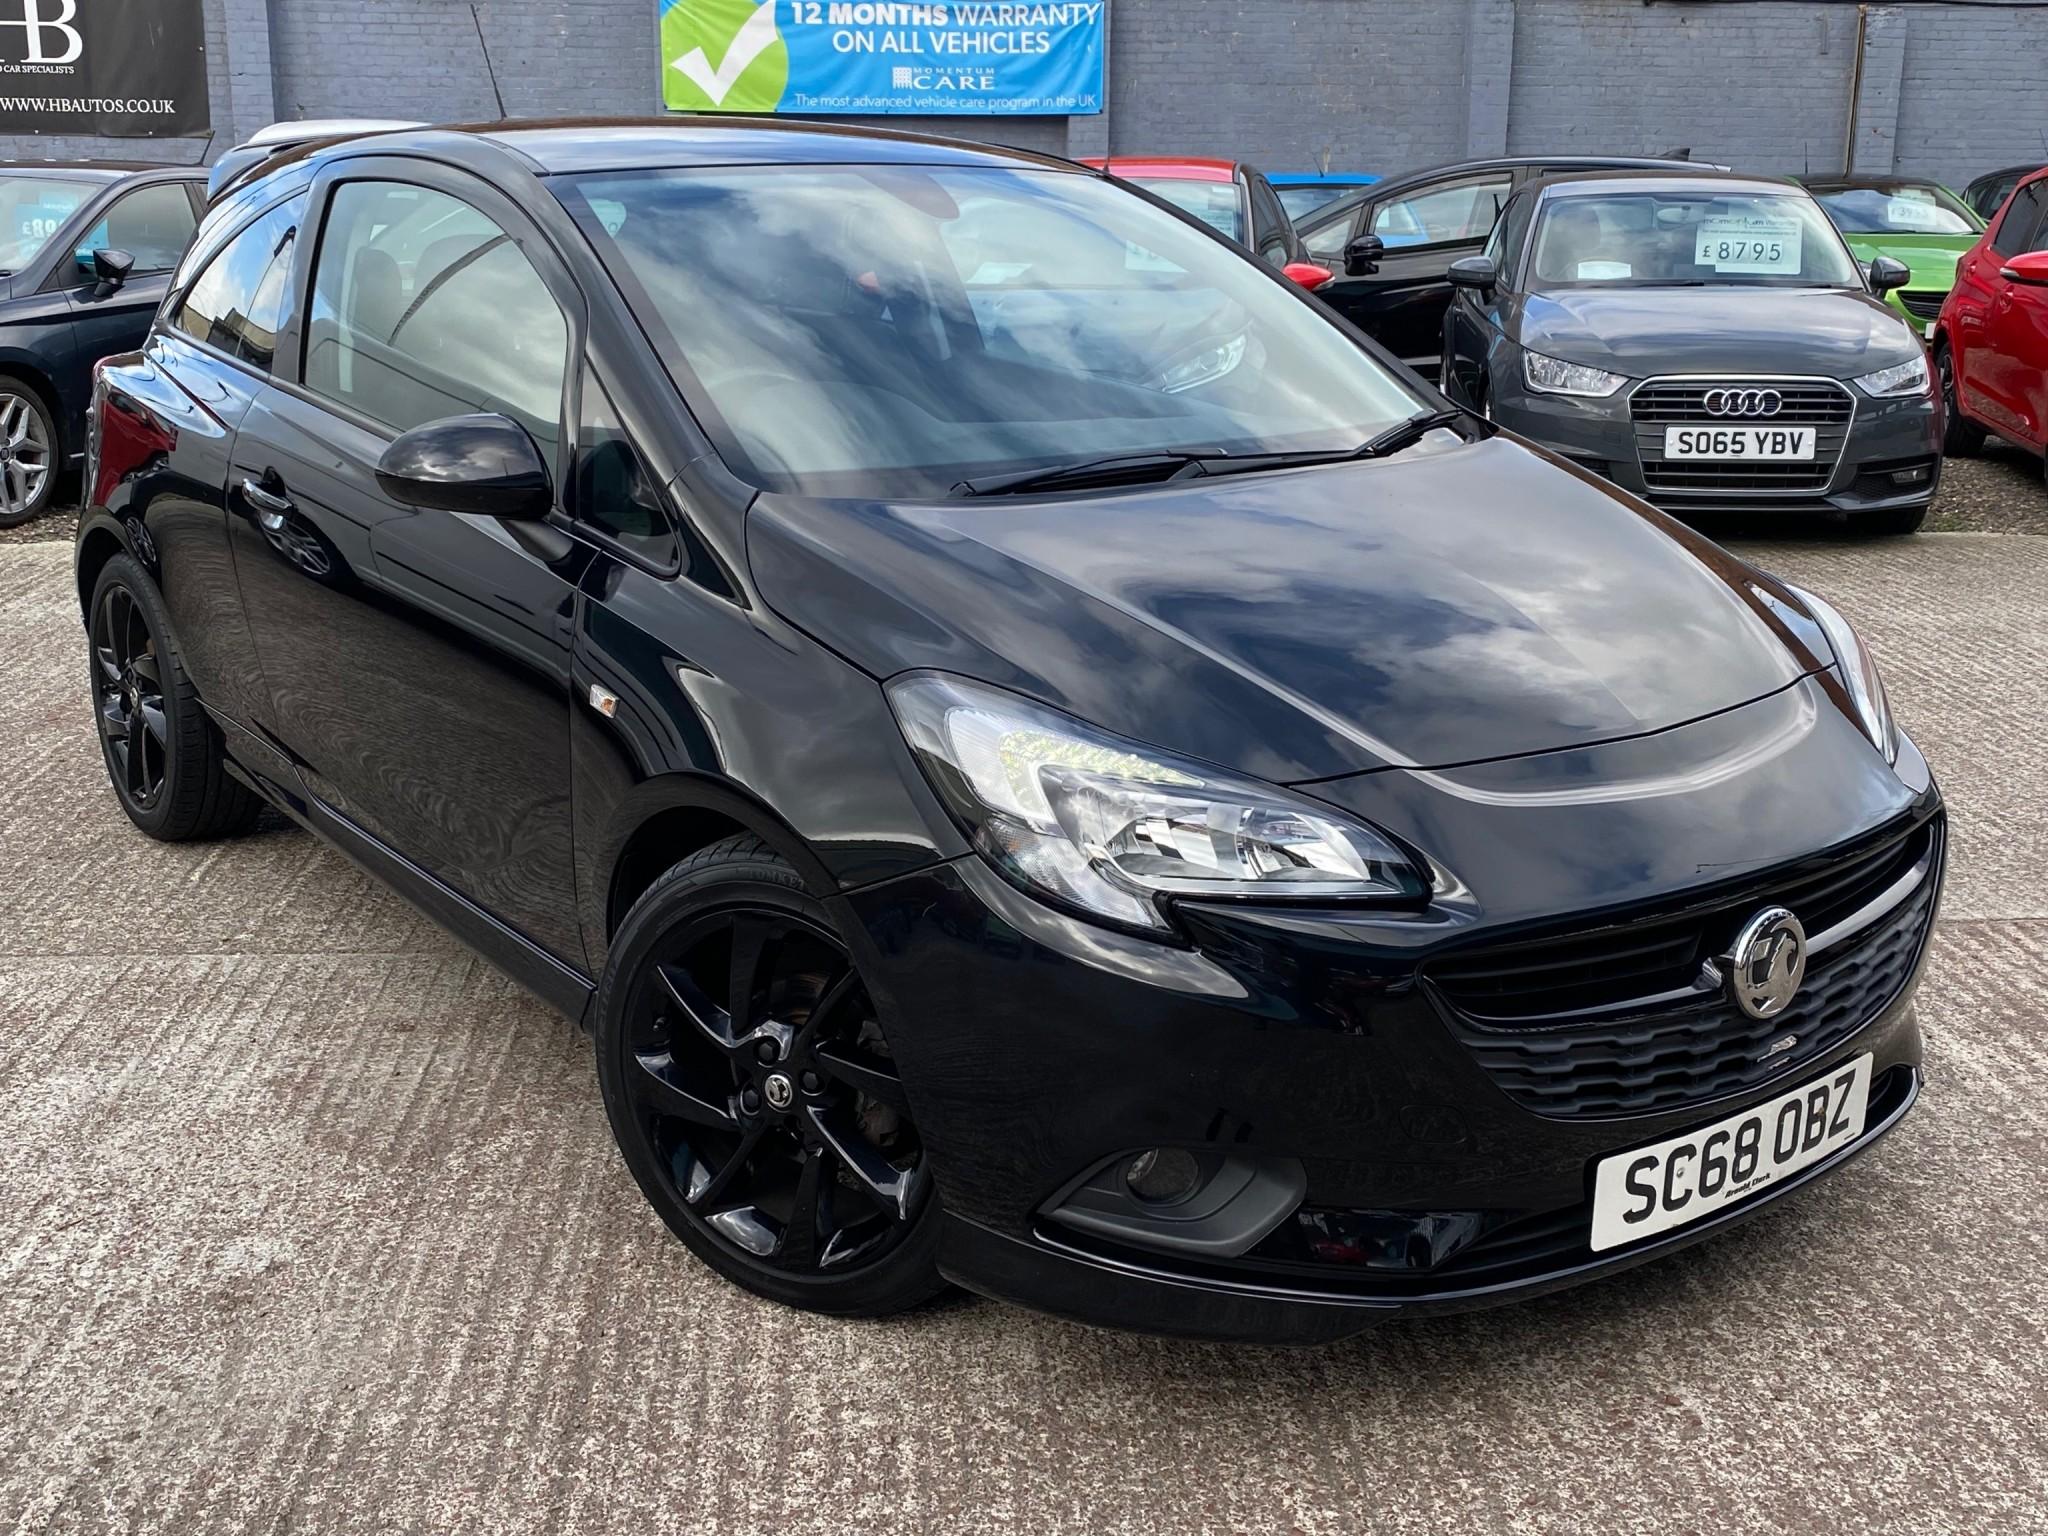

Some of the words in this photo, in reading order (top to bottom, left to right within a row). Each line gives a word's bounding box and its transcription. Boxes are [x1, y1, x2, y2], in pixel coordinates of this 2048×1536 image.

[791, 2, 823, 25] 12
[828, 3, 949, 27] MONTHS
[954, 2, 1100, 26] WARRANTY
[832, 30, 874, 53] ON
[880, 30, 925, 54] ALL
[929, 31, 1050, 54] VEHICLES
[3, 64, 21, 73] CAR
[22, 65, 75, 74] SPECIALISTS
[913, 76, 995, 90] CARE
[0, 97, 176, 114] WWW.HBAUTOS.CO.UK
[795, 93, 818, 107] The
[820, 94, 849, 107] most
[855, 95, 912, 108] advanced
[914, 96, 957, 108] vehicle
[959, 98, 986, 108] care
[988, 97, 1040, 111] program
[1043, 96, 1054, 108] in
[1056, 95, 1076, 108] the
[1078, 94, 1096, 107] UK
[1678, 431, 1746, 454] SO65
[1754, 431, 1804, 455] YBV
[1622, 1115, 1763, 1225] SC68
[1773, 1067, 1857, 1166] OBZ
